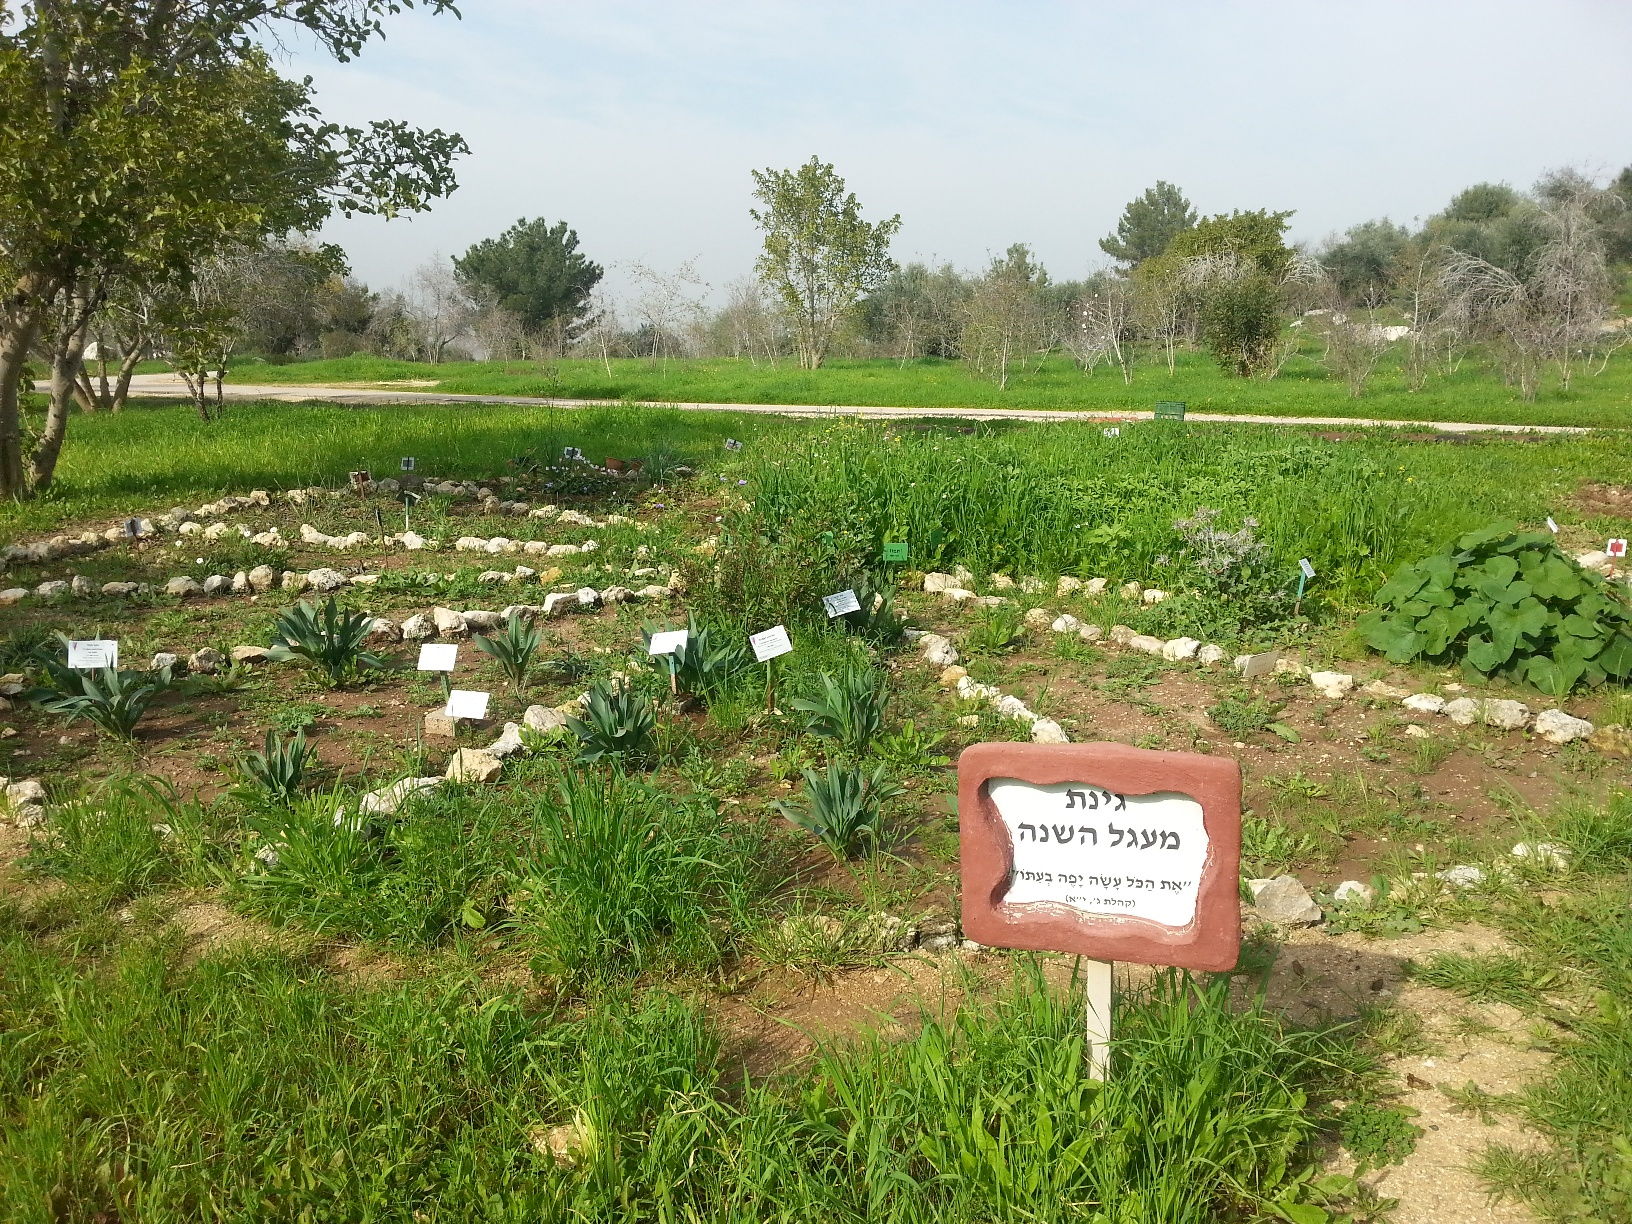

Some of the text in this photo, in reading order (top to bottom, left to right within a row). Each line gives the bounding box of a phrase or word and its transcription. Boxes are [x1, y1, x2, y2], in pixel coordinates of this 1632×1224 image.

[1065, 789, 1127, 812] גינת
[1017, 822, 1181, 851] מעגל השנה
